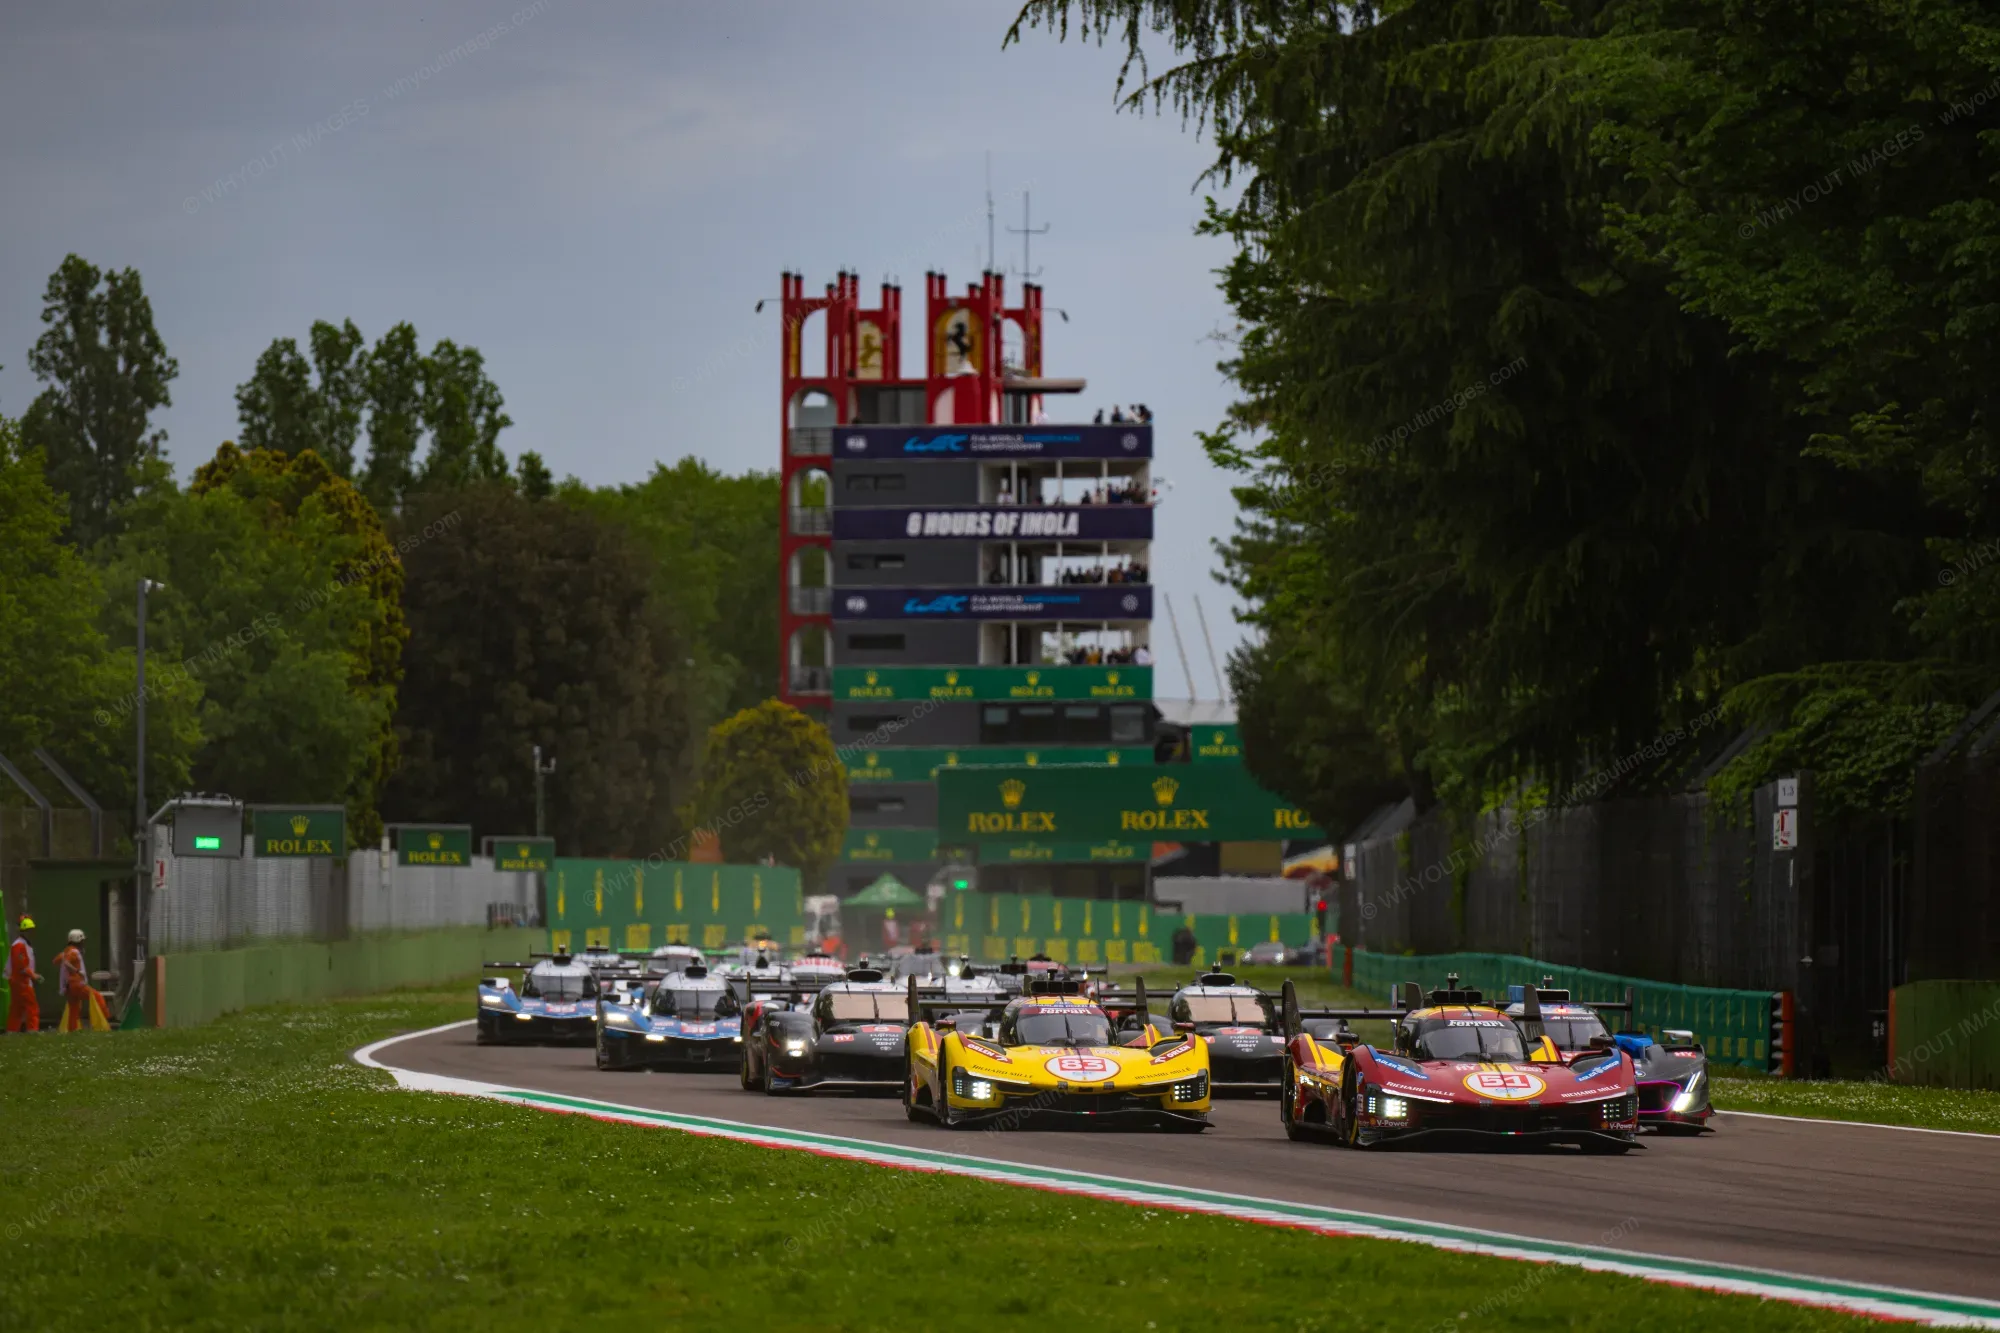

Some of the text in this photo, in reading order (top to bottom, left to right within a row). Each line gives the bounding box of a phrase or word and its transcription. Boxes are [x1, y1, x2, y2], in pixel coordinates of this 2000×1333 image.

[924, 512, 990, 536] HOURS
[992, 512, 1019, 536] OF
[1020, 512, 1079, 535] IMOLA
[968, 812, 1056, 832] ROLEX
[1120, 809, 1209, 830] ROLEX
[267, 839, 332, 854] ROLEX
[408, 851, 461, 864] ROLEX
[1447, 1020, 1505, 1028] Ferrari
[834, 1034, 852, 1042] HY
[967, 1043, 995, 1058] ORLEN
[1166, 1044, 1191, 1058] ORLEN
[972, 1064, 1008, 1076] RICHARD
[1060, 1058, 1104, 1070] 83
[1375, 1058, 1428, 1080] ADLER GROUP
[1134, 1071, 1169, 1080] RICHARD
[1481, 1074, 1529, 1088] 51
[1386, 1081, 1426, 1093] RICHARD
[1561, 1084, 1621, 1098] RICHARD MILLE
[1376, 1118, 1409, 1128] V-Power
[1609, 1122, 1635, 1130] V-Power
